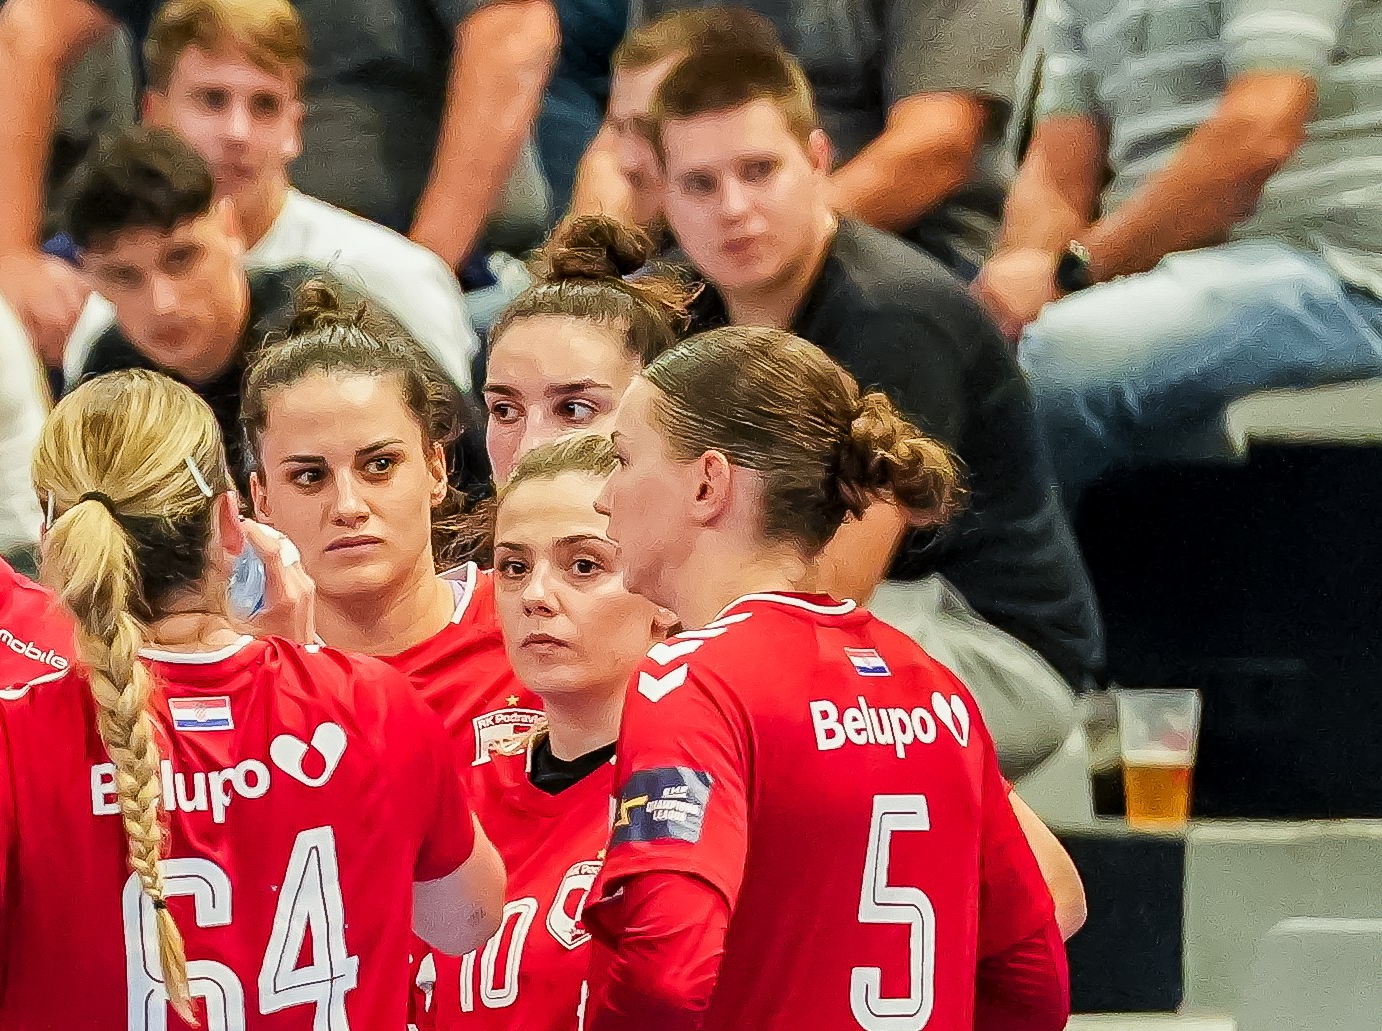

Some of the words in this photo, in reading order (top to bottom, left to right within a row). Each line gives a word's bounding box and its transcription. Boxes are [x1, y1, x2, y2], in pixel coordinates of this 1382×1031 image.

[495, 712, 536, 724] Podrav
[810, 696, 936, 758] Belupo
[90, 759, 271, 823] Blupo
[122, 825, 359, 1031] 64
[460, 896, 539, 1013] 10
[850, 795, 936, 1031] 5
